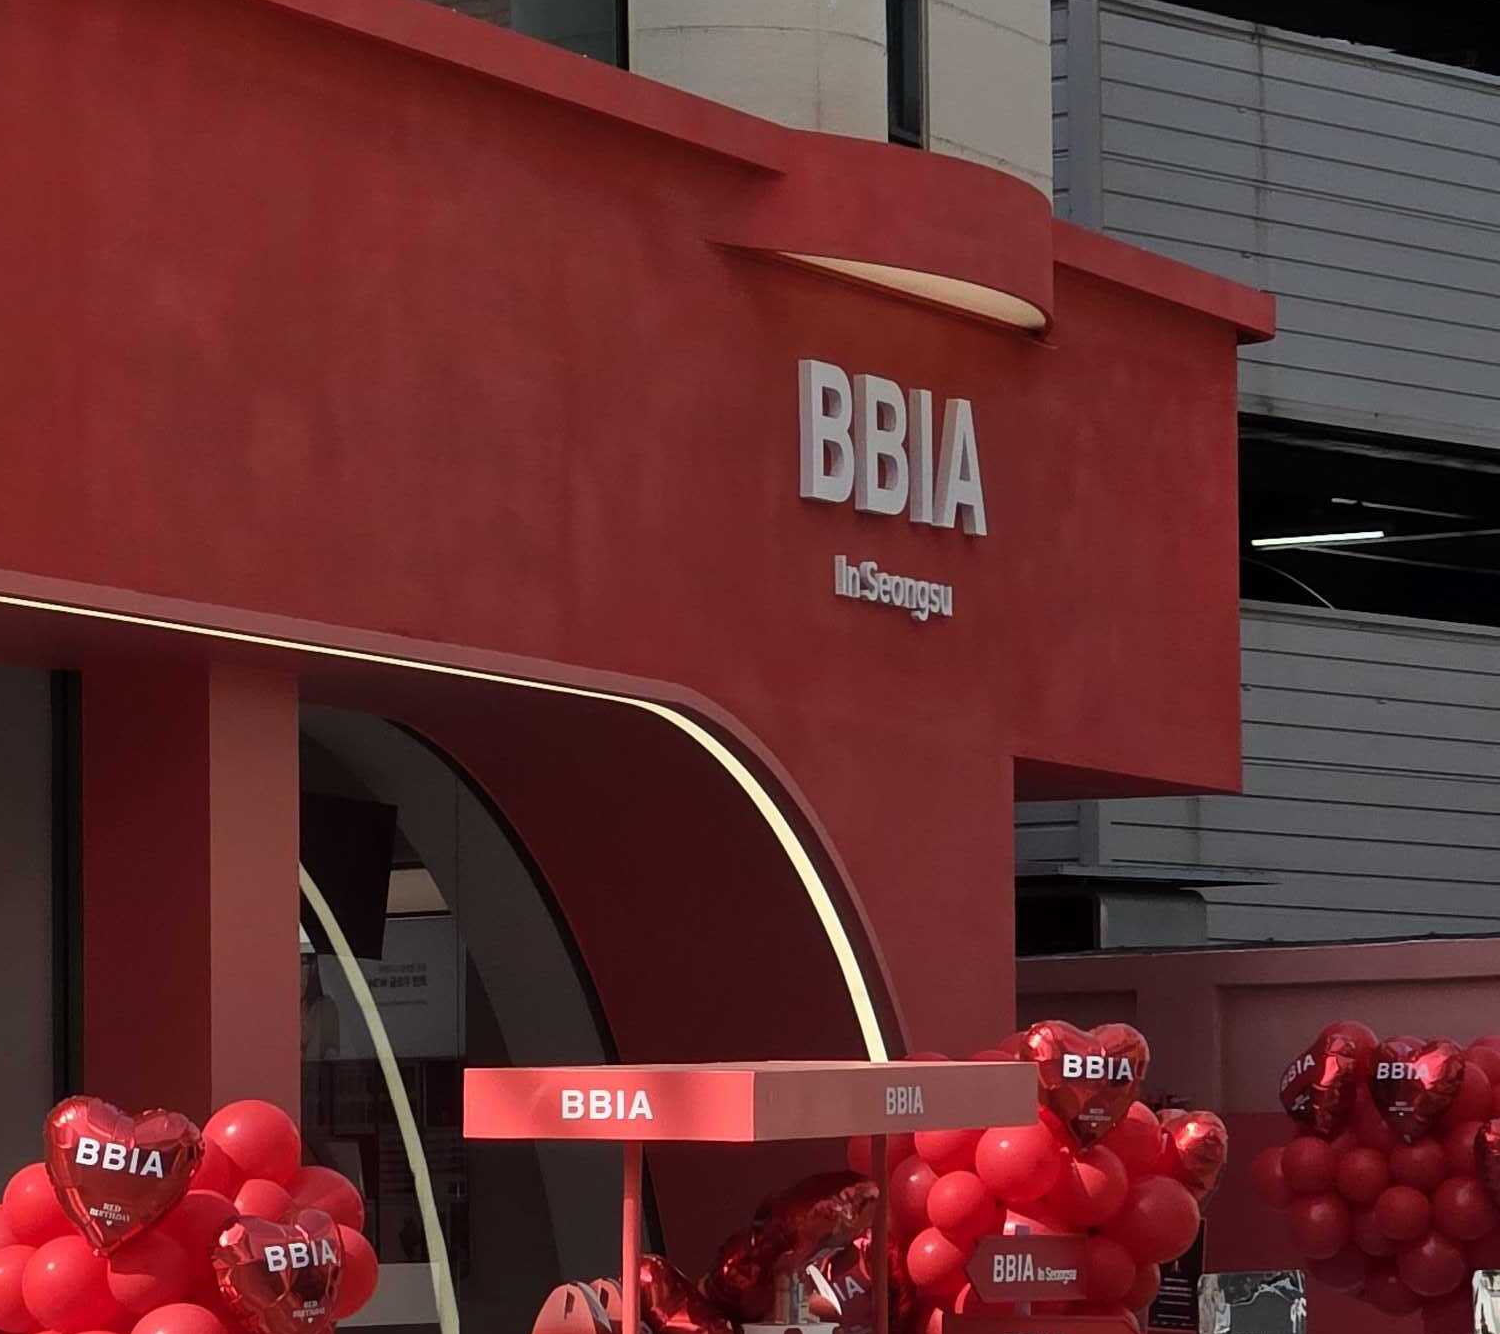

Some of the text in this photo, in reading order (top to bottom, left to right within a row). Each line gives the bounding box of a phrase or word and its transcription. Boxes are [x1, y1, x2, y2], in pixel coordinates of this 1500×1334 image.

[798, 359, 987, 536] BBIA
[835, 555, 953, 621] In Seongsu
[1061, 1054, 1134, 1082] BBIA
[561, 1089, 653, 1120] BBIA
[885, 1086, 924, 1115] BBIA
[75, 1136, 164, 1179] BBIA
[264, 1239, 337, 1272] BBIA
[993, 1253, 1035, 1283] BBIA
